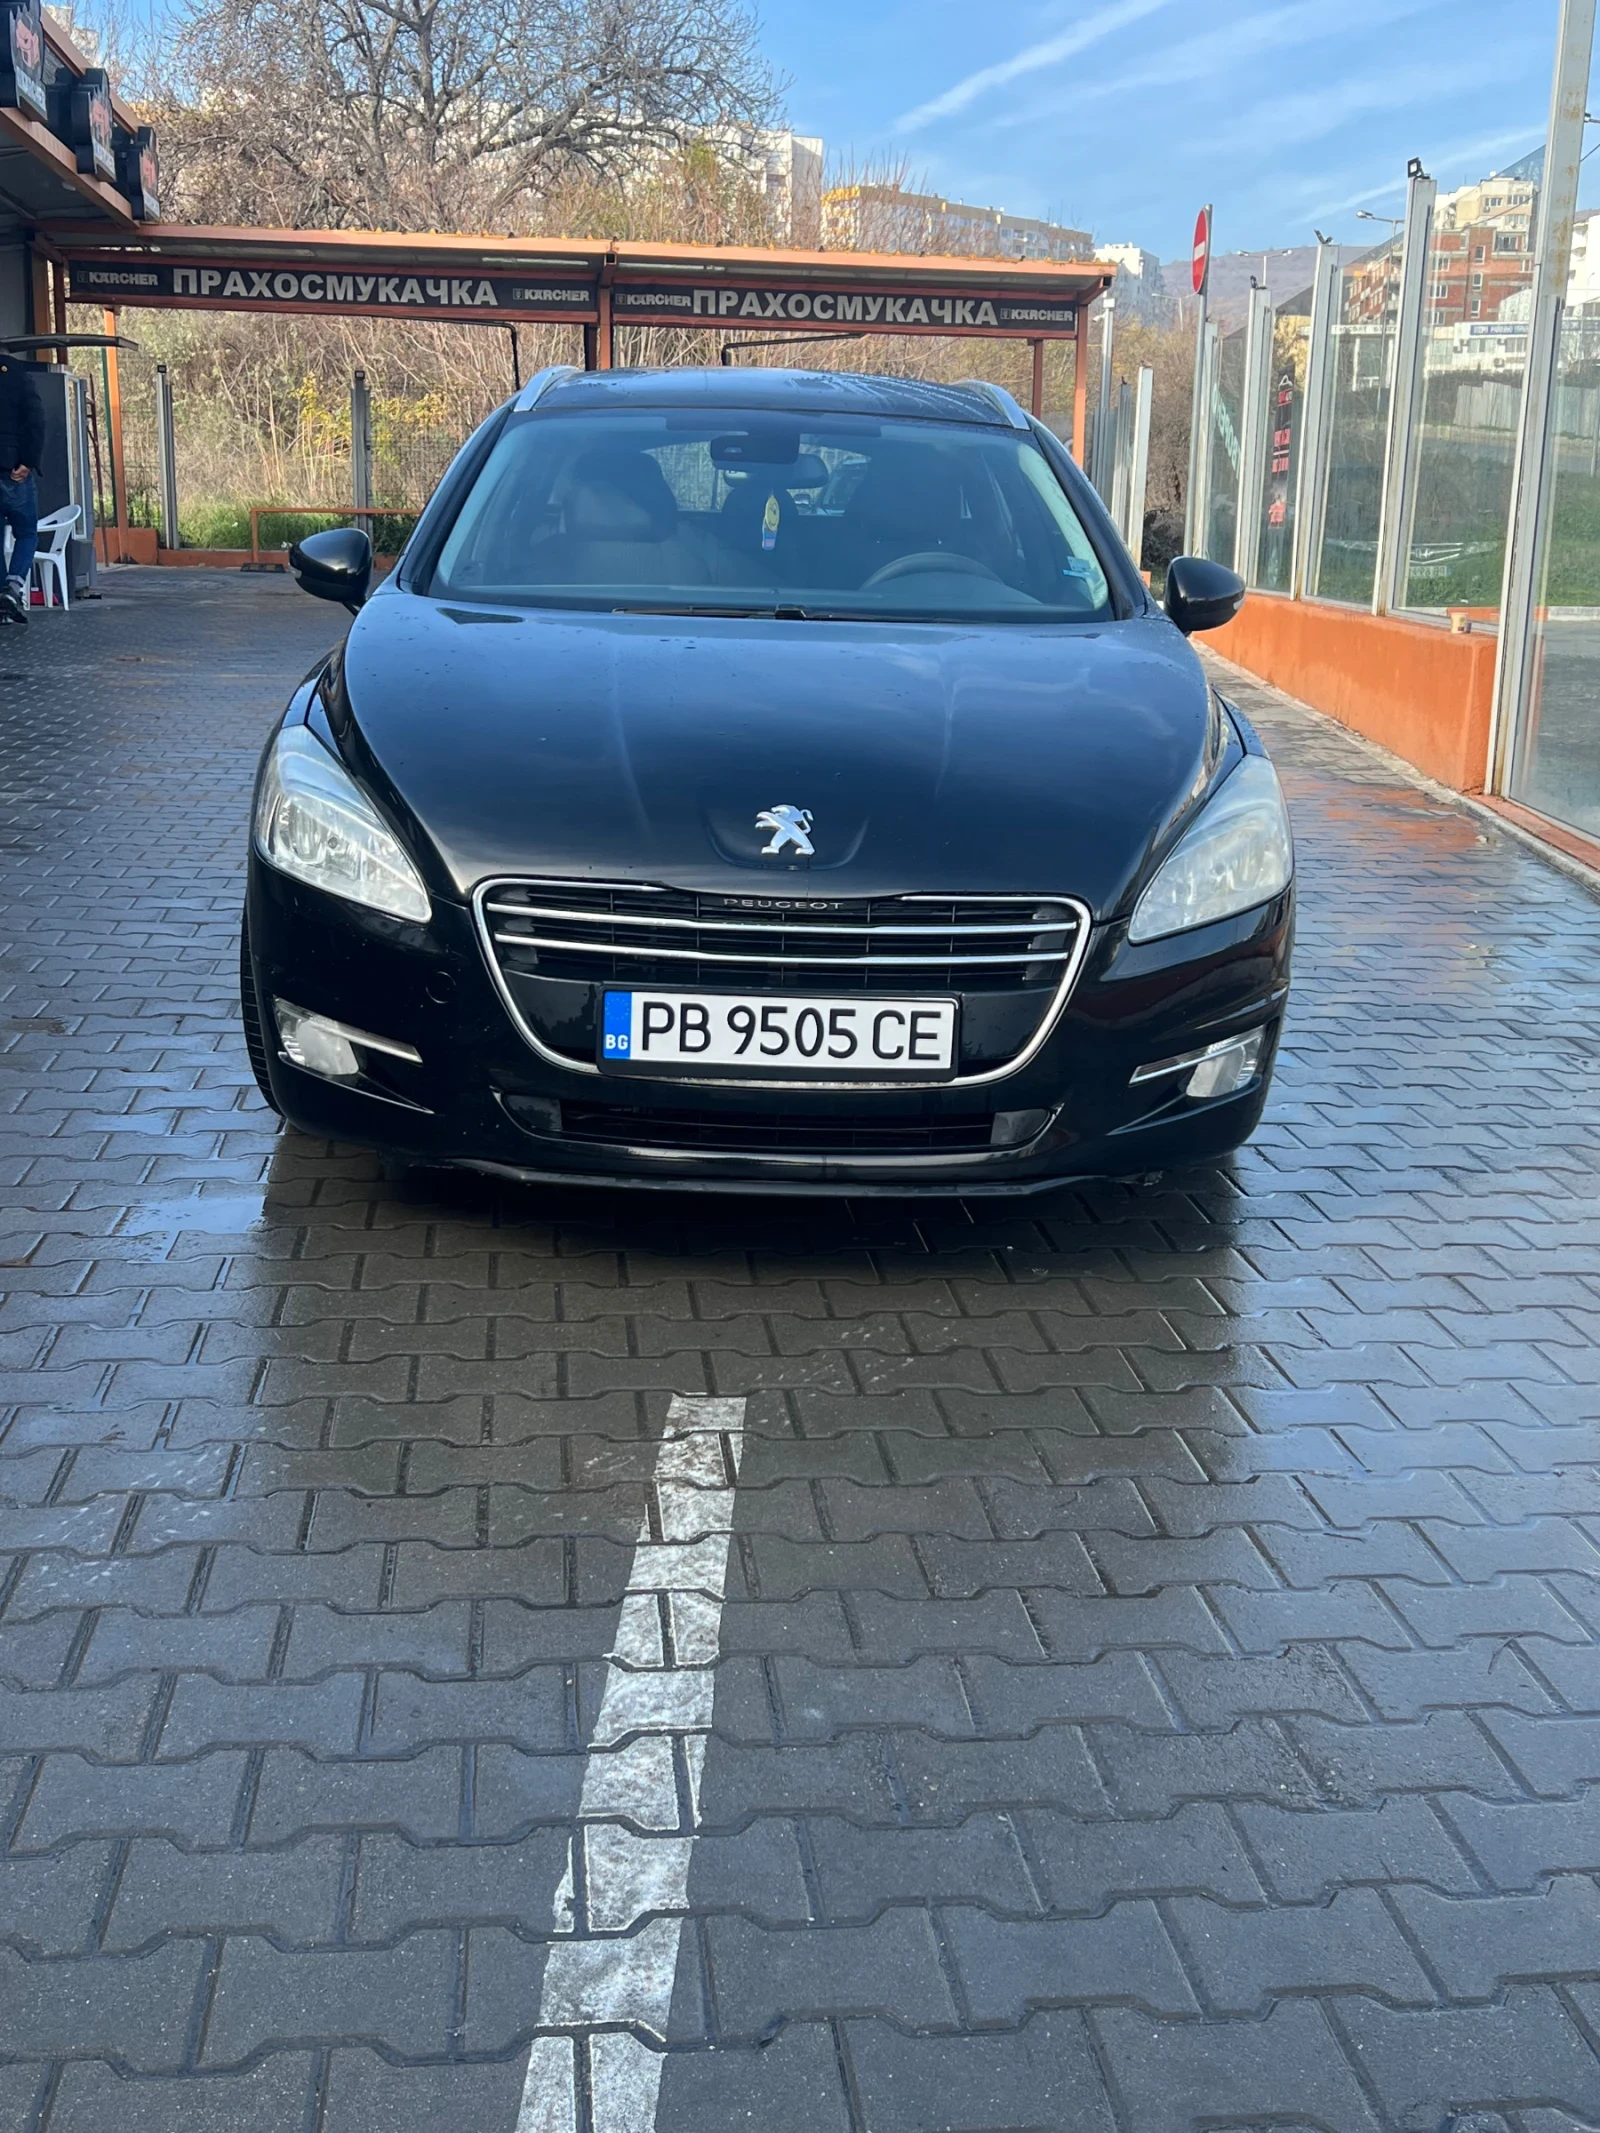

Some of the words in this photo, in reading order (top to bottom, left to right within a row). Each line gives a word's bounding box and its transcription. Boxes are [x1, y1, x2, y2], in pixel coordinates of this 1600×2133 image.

[173, 268, 498, 306] ПРАХОСМУКАЧКА
[693, 289, 998, 326] ПРАХОСМУКАЧКА
[723, 898, 844, 910] PEUGEOT
[604, 1033, 629, 1051] BG
[641, 1001, 712, 1053] PB
[726, 1004, 858, 1059] 9505
[871, 1009, 942, 1061] CE
